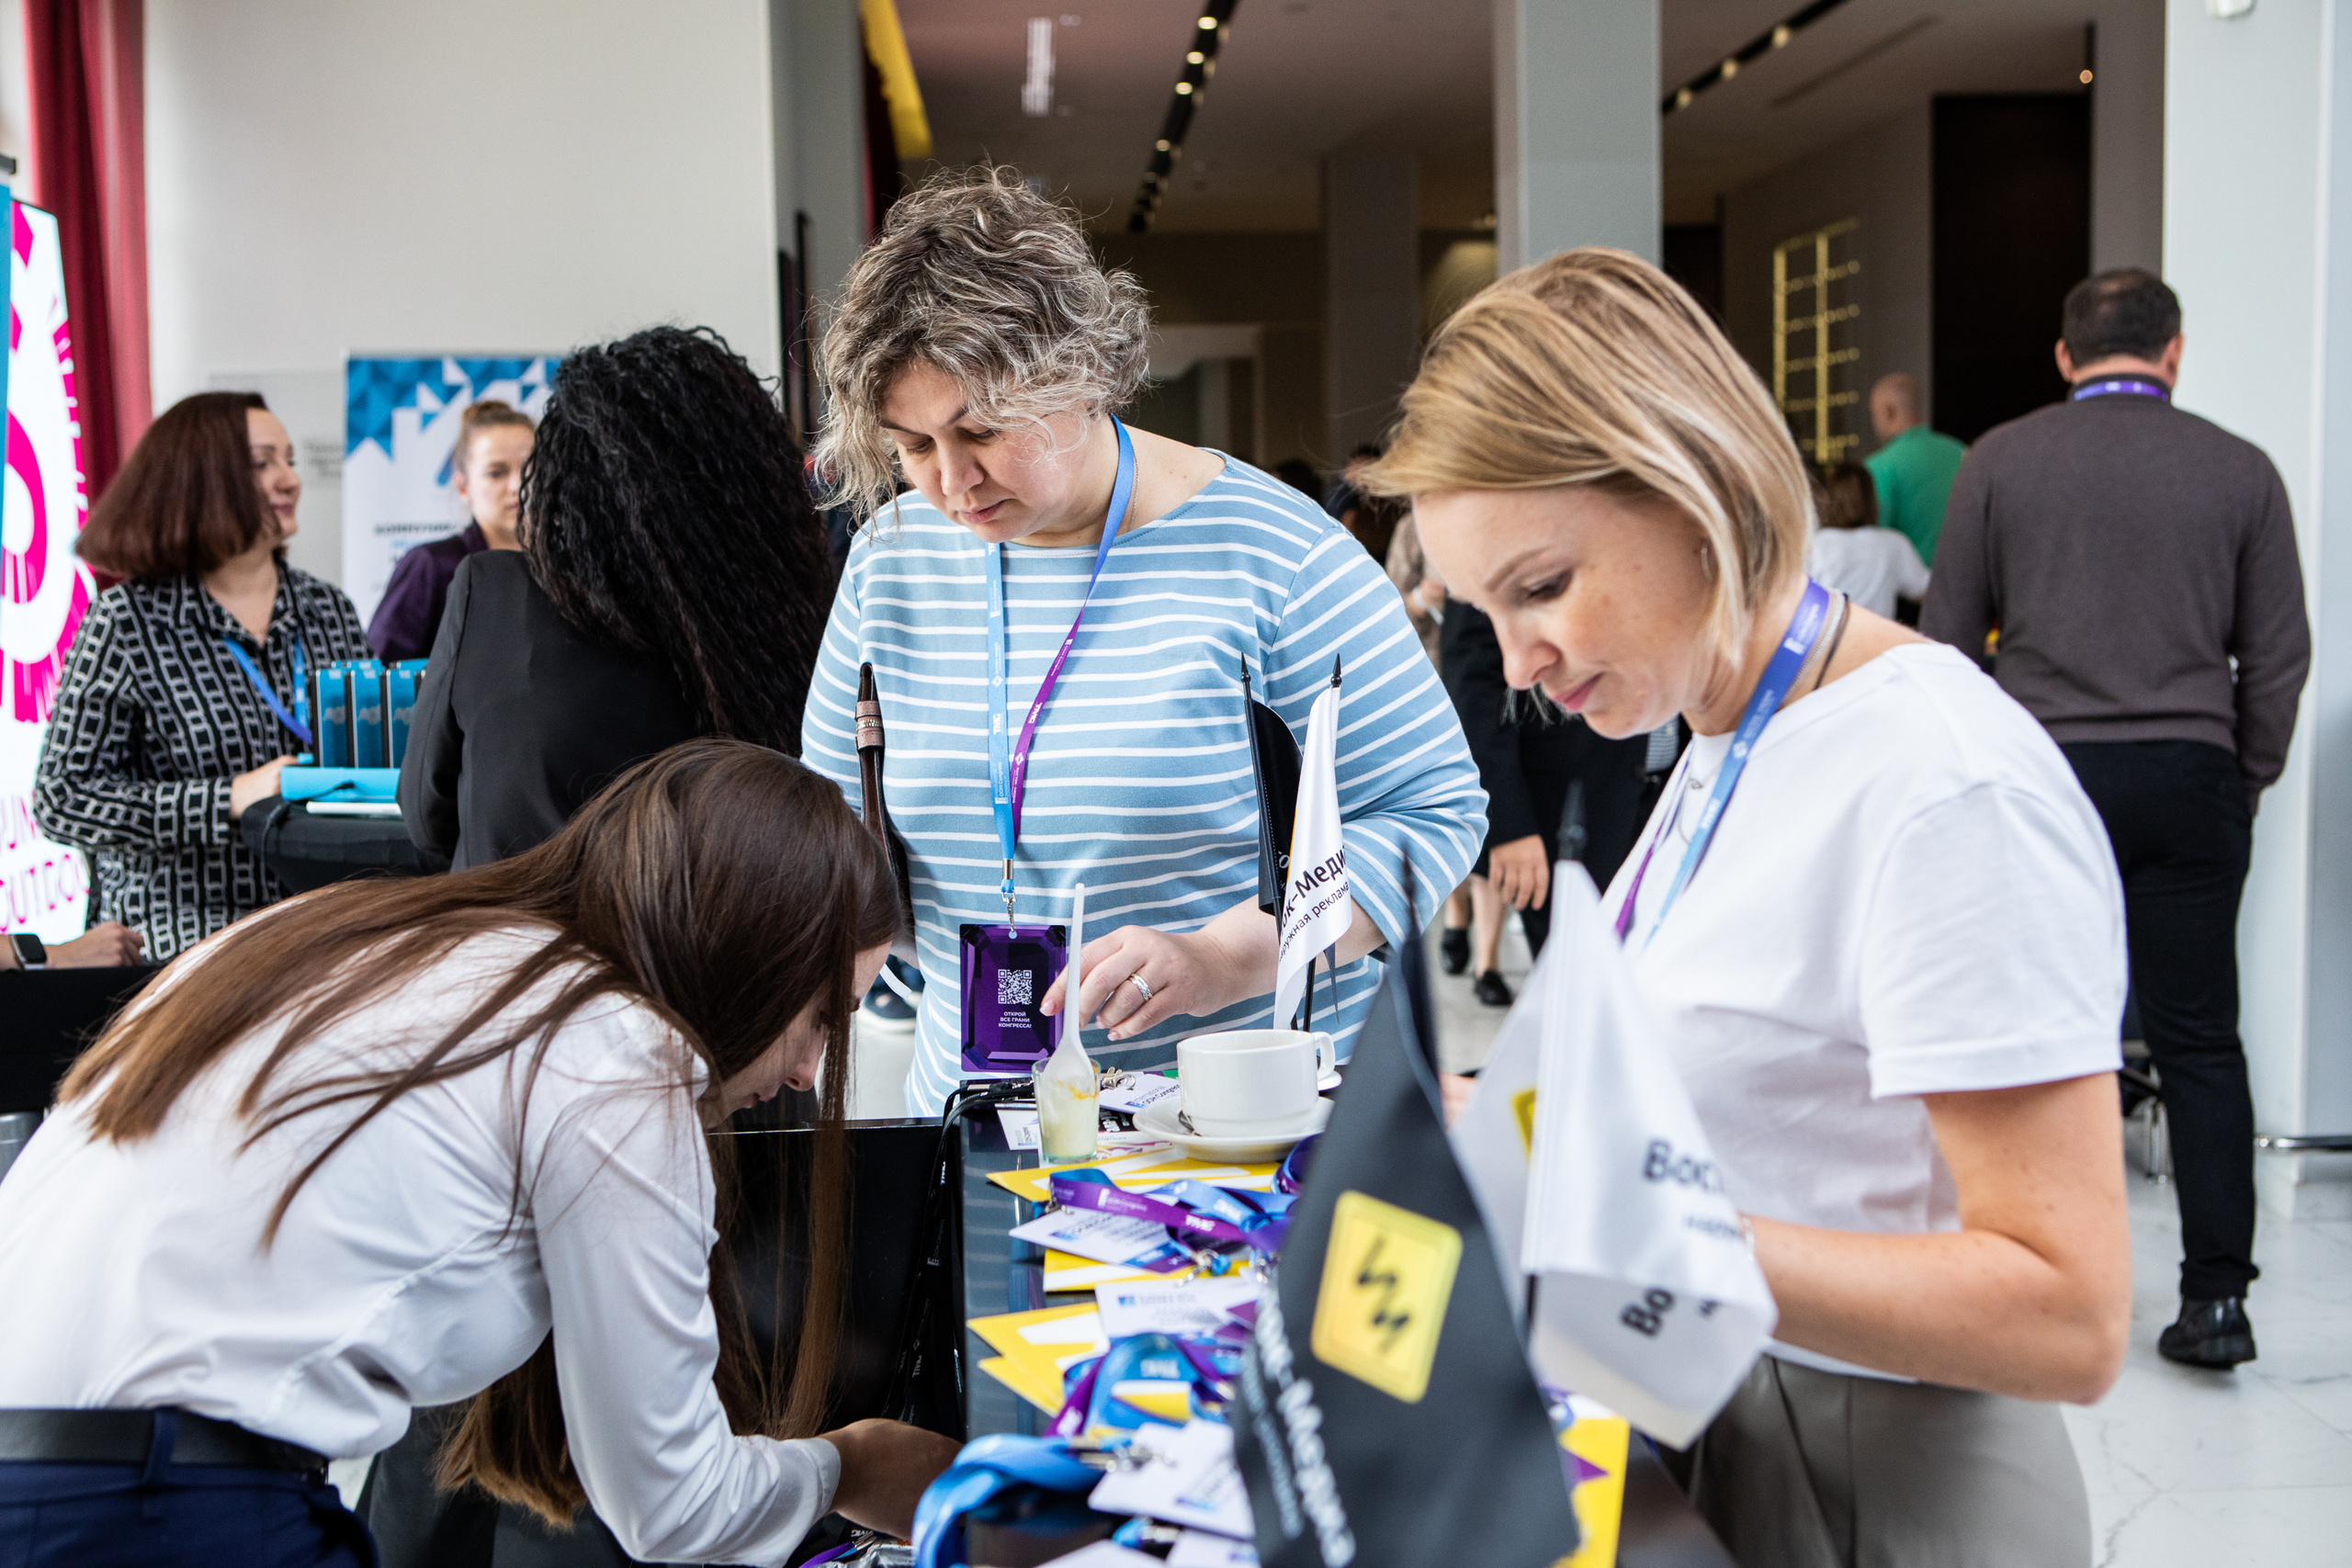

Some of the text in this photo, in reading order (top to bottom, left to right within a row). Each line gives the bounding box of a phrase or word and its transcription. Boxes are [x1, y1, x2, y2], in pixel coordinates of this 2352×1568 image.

[993, 713, 1001, 735] TMG
[1028, 702, 1043, 724] TMG
[1281, 845, 1348, 931] ок-Меди
[1311, 880, 1350, 919] реклама
